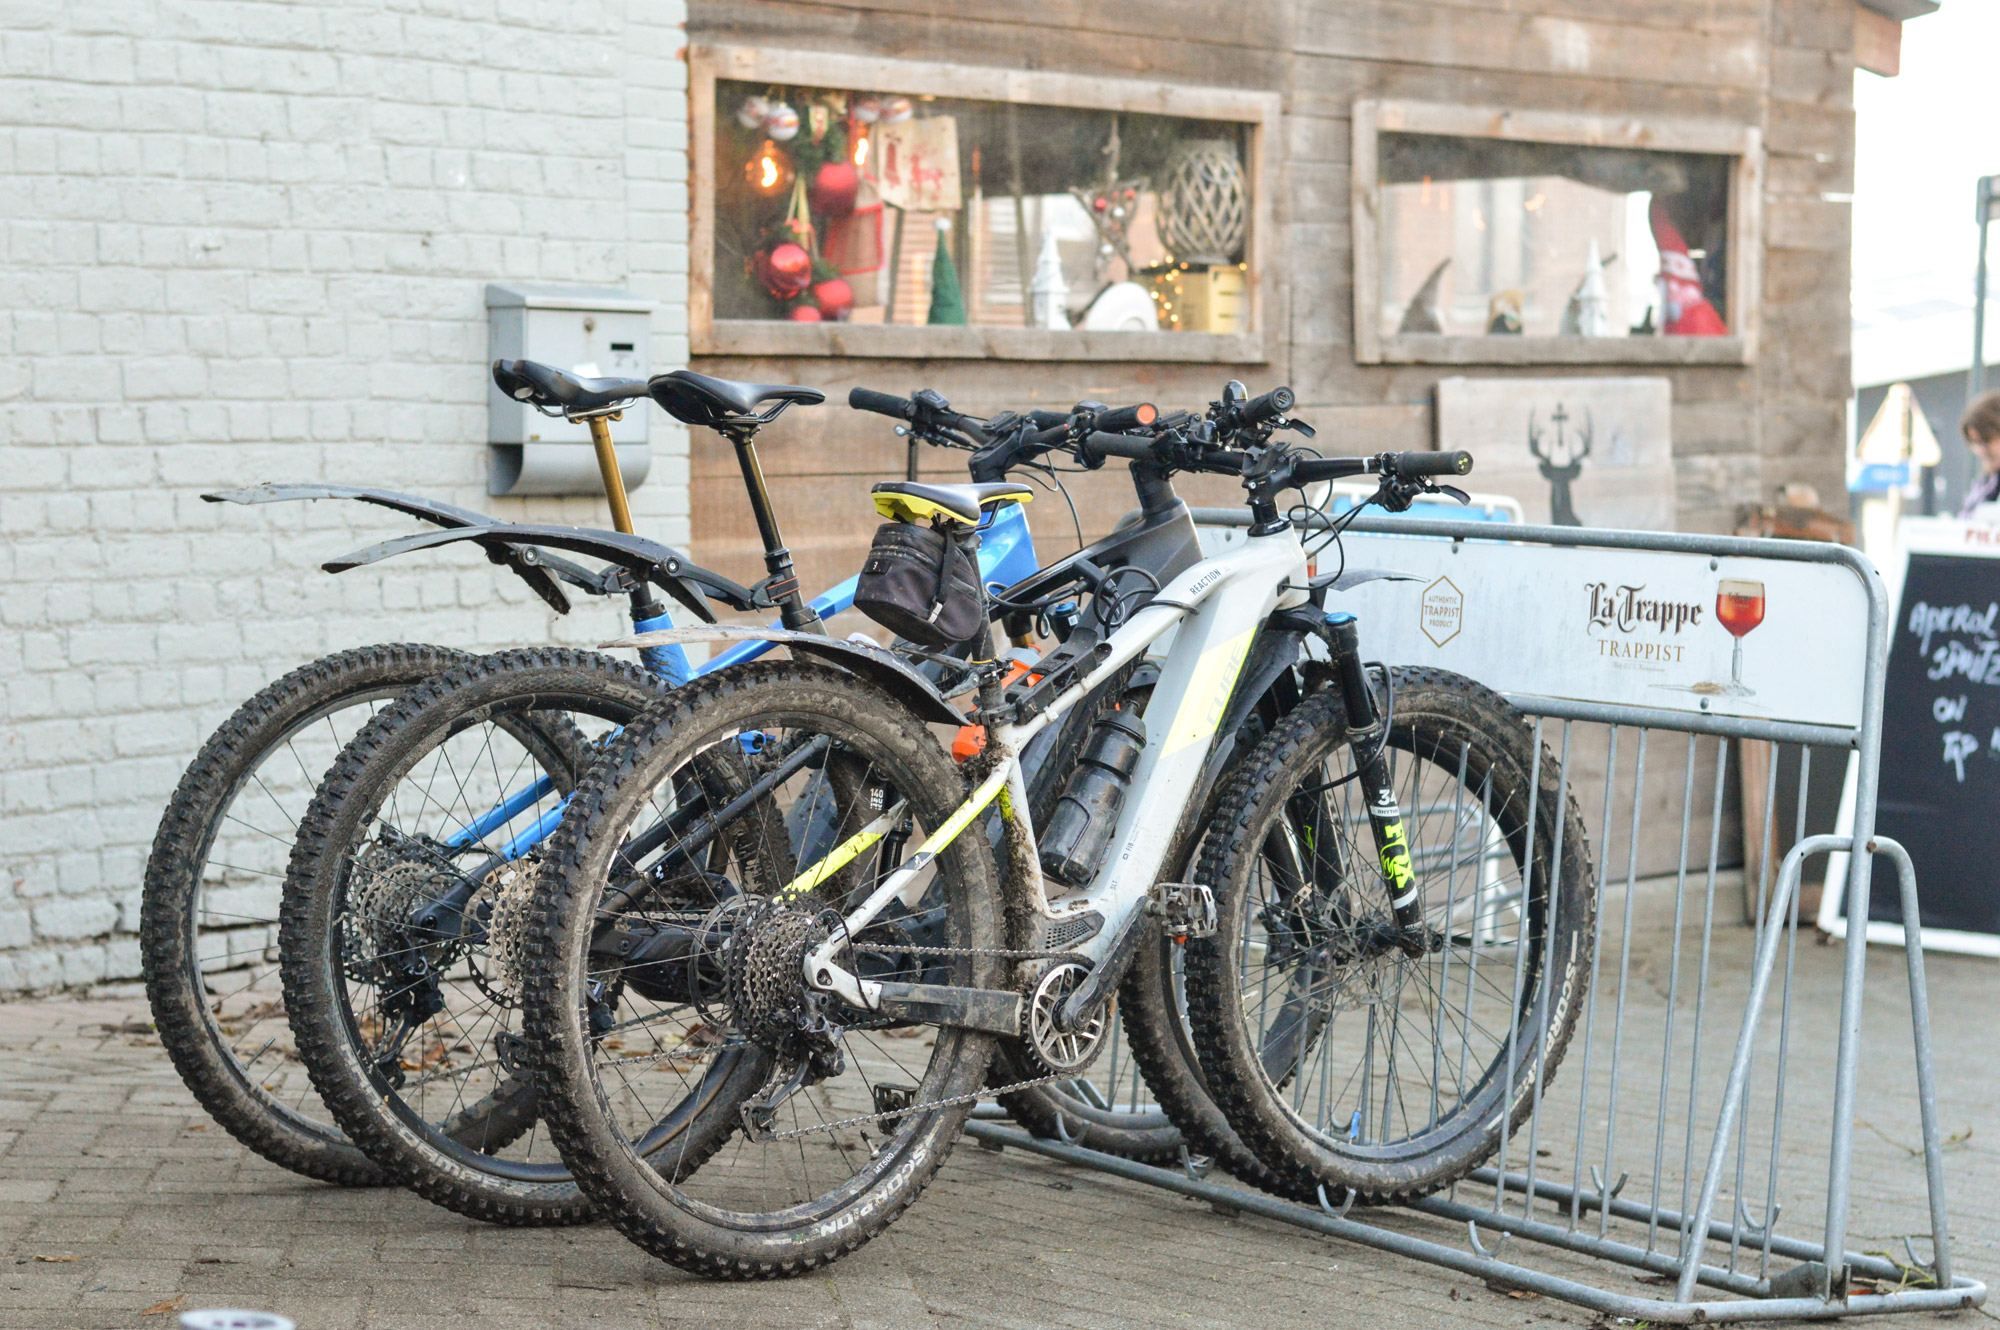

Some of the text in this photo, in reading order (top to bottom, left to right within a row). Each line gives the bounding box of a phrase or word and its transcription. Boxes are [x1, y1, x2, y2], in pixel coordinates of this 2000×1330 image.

[1189, 568, 1222, 595] REACTION
[1424, 605, 1460, 618] TRAPPIST
[1428, 595, 1457, 605] AUTHENTIC
[1429, 618, 1454, 628] PRODUCT
[1597, 639, 1685, 663] TRAPPIST
[1527, 961, 1577, 1085] SCORPN
[873, 1152, 895, 1175] MT500
